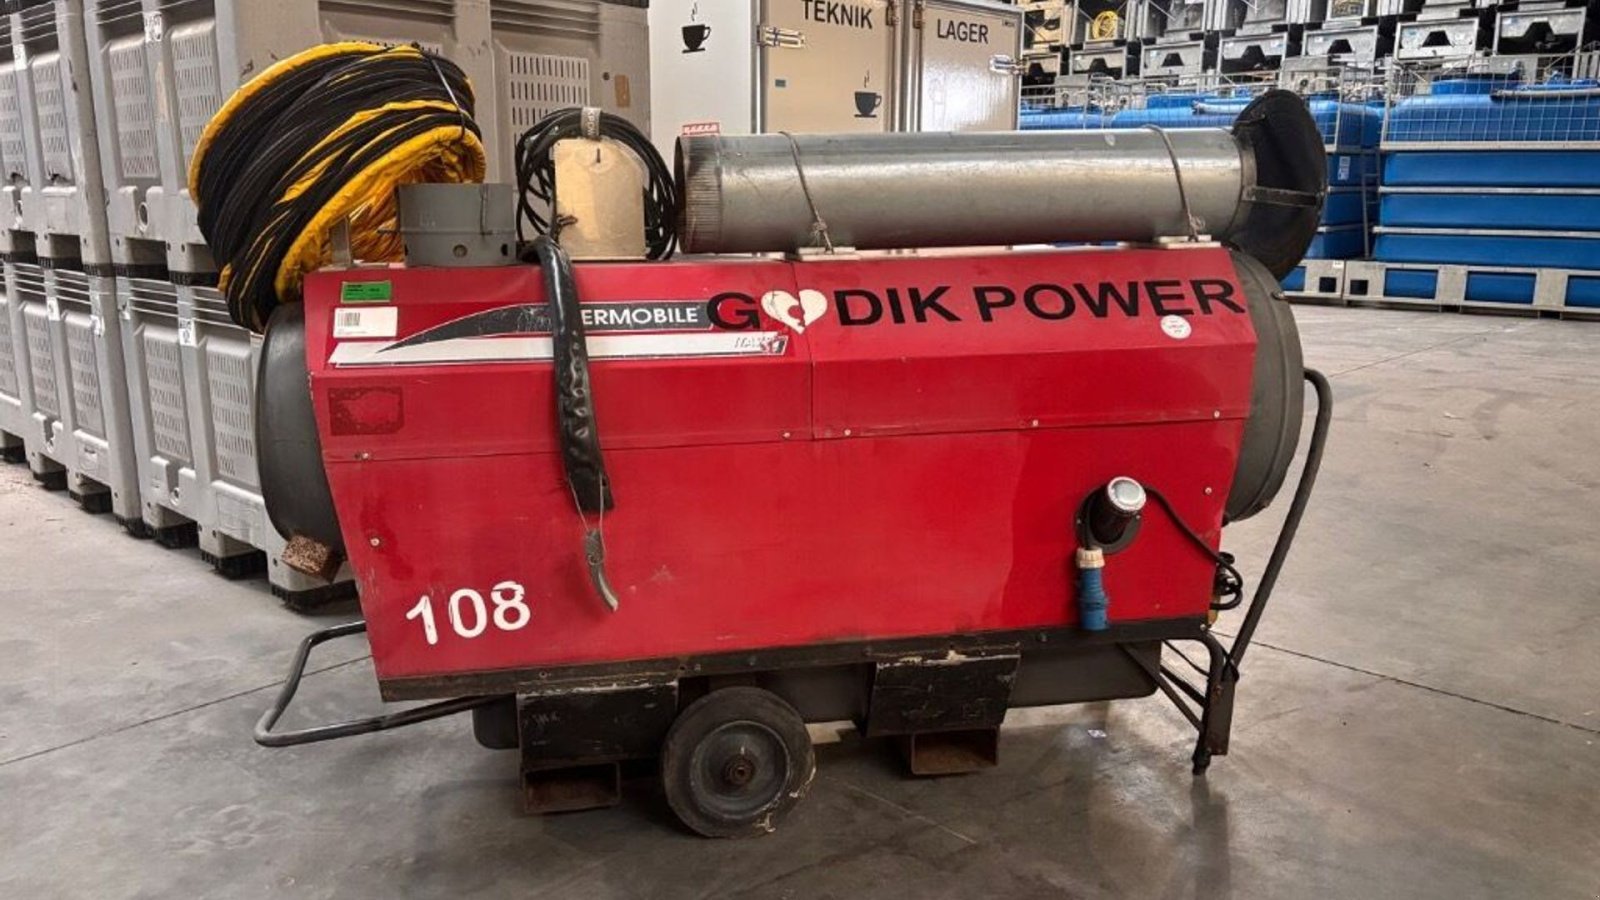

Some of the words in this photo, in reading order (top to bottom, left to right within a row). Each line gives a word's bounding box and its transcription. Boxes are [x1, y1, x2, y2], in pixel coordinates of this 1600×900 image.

[802, 0, 873, 29] TEKNIK
[937, 18, 989, 45] LAGER
[974, 279, 1246, 322] POWER
[580, 307, 698, 326] ERMOBILE
[406, 580, 531, 645] 108
